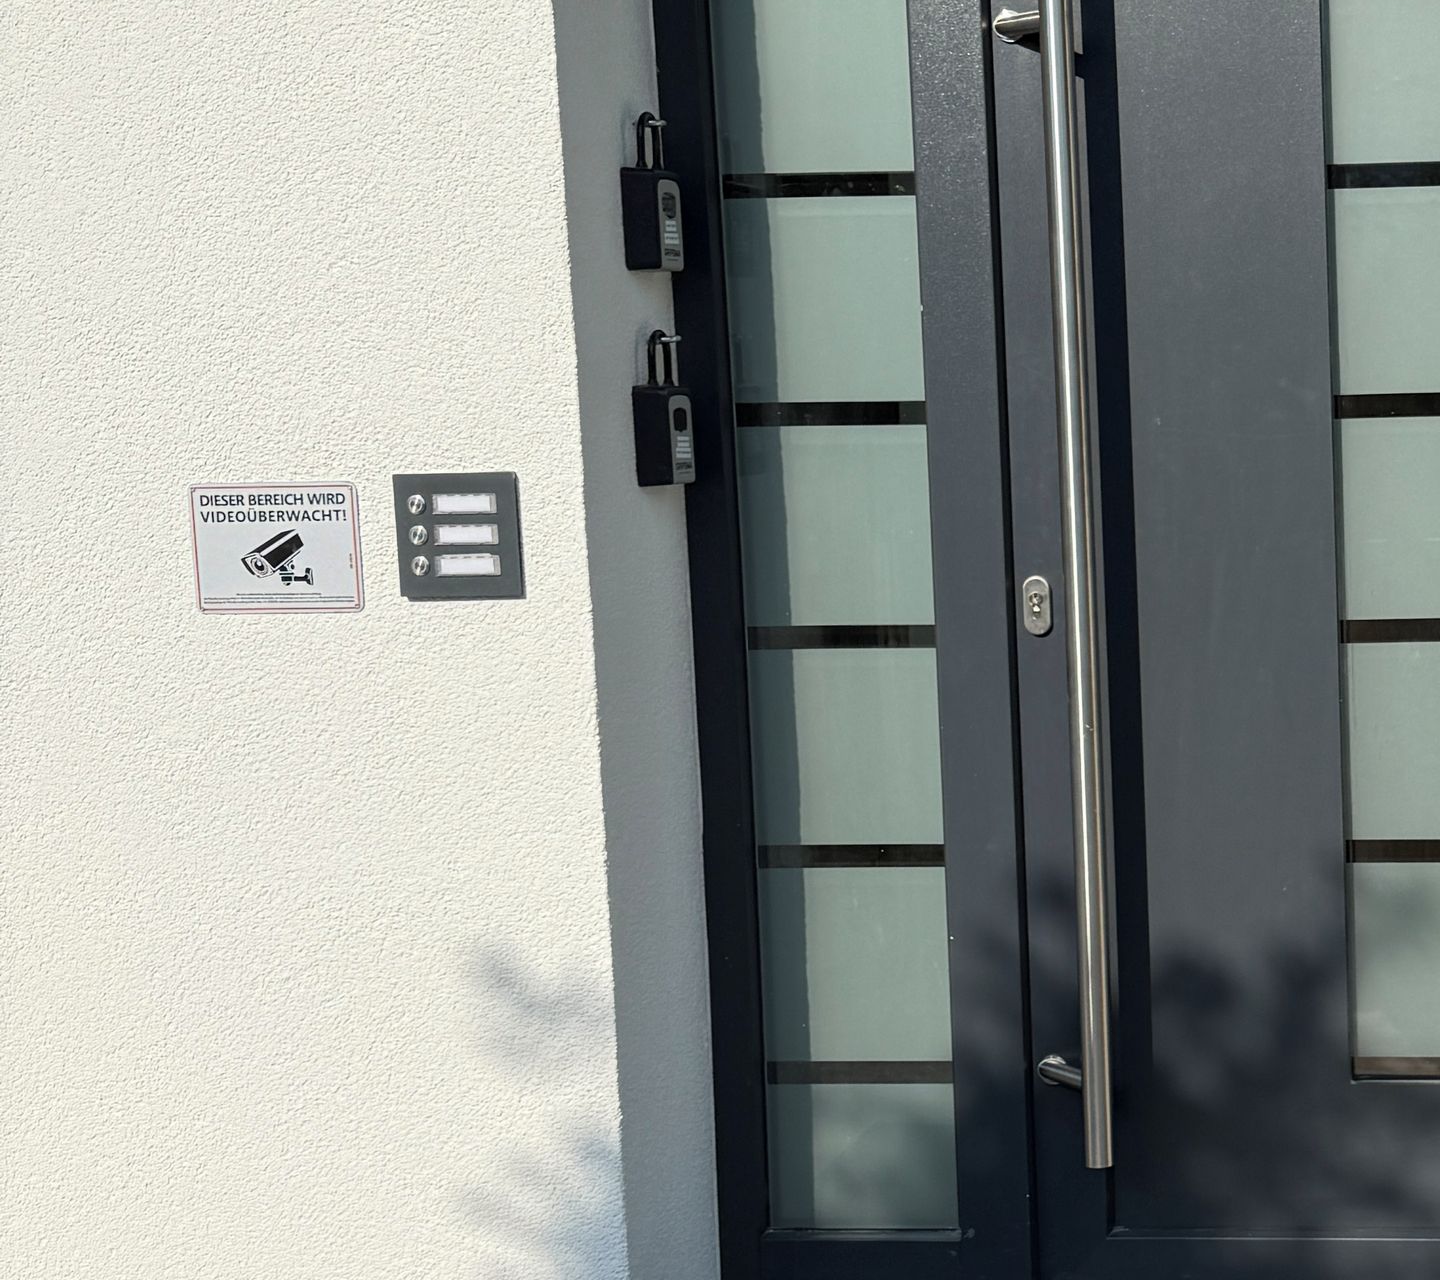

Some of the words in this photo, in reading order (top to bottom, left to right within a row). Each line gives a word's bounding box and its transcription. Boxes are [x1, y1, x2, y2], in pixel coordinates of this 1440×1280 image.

[200, 495, 245, 506] DIESER
[249, 494, 304, 506] BEREICH
[307, 493, 346, 505] WIRD
[200, 508, 346, 523] VIDEOÜBERWACHT!
